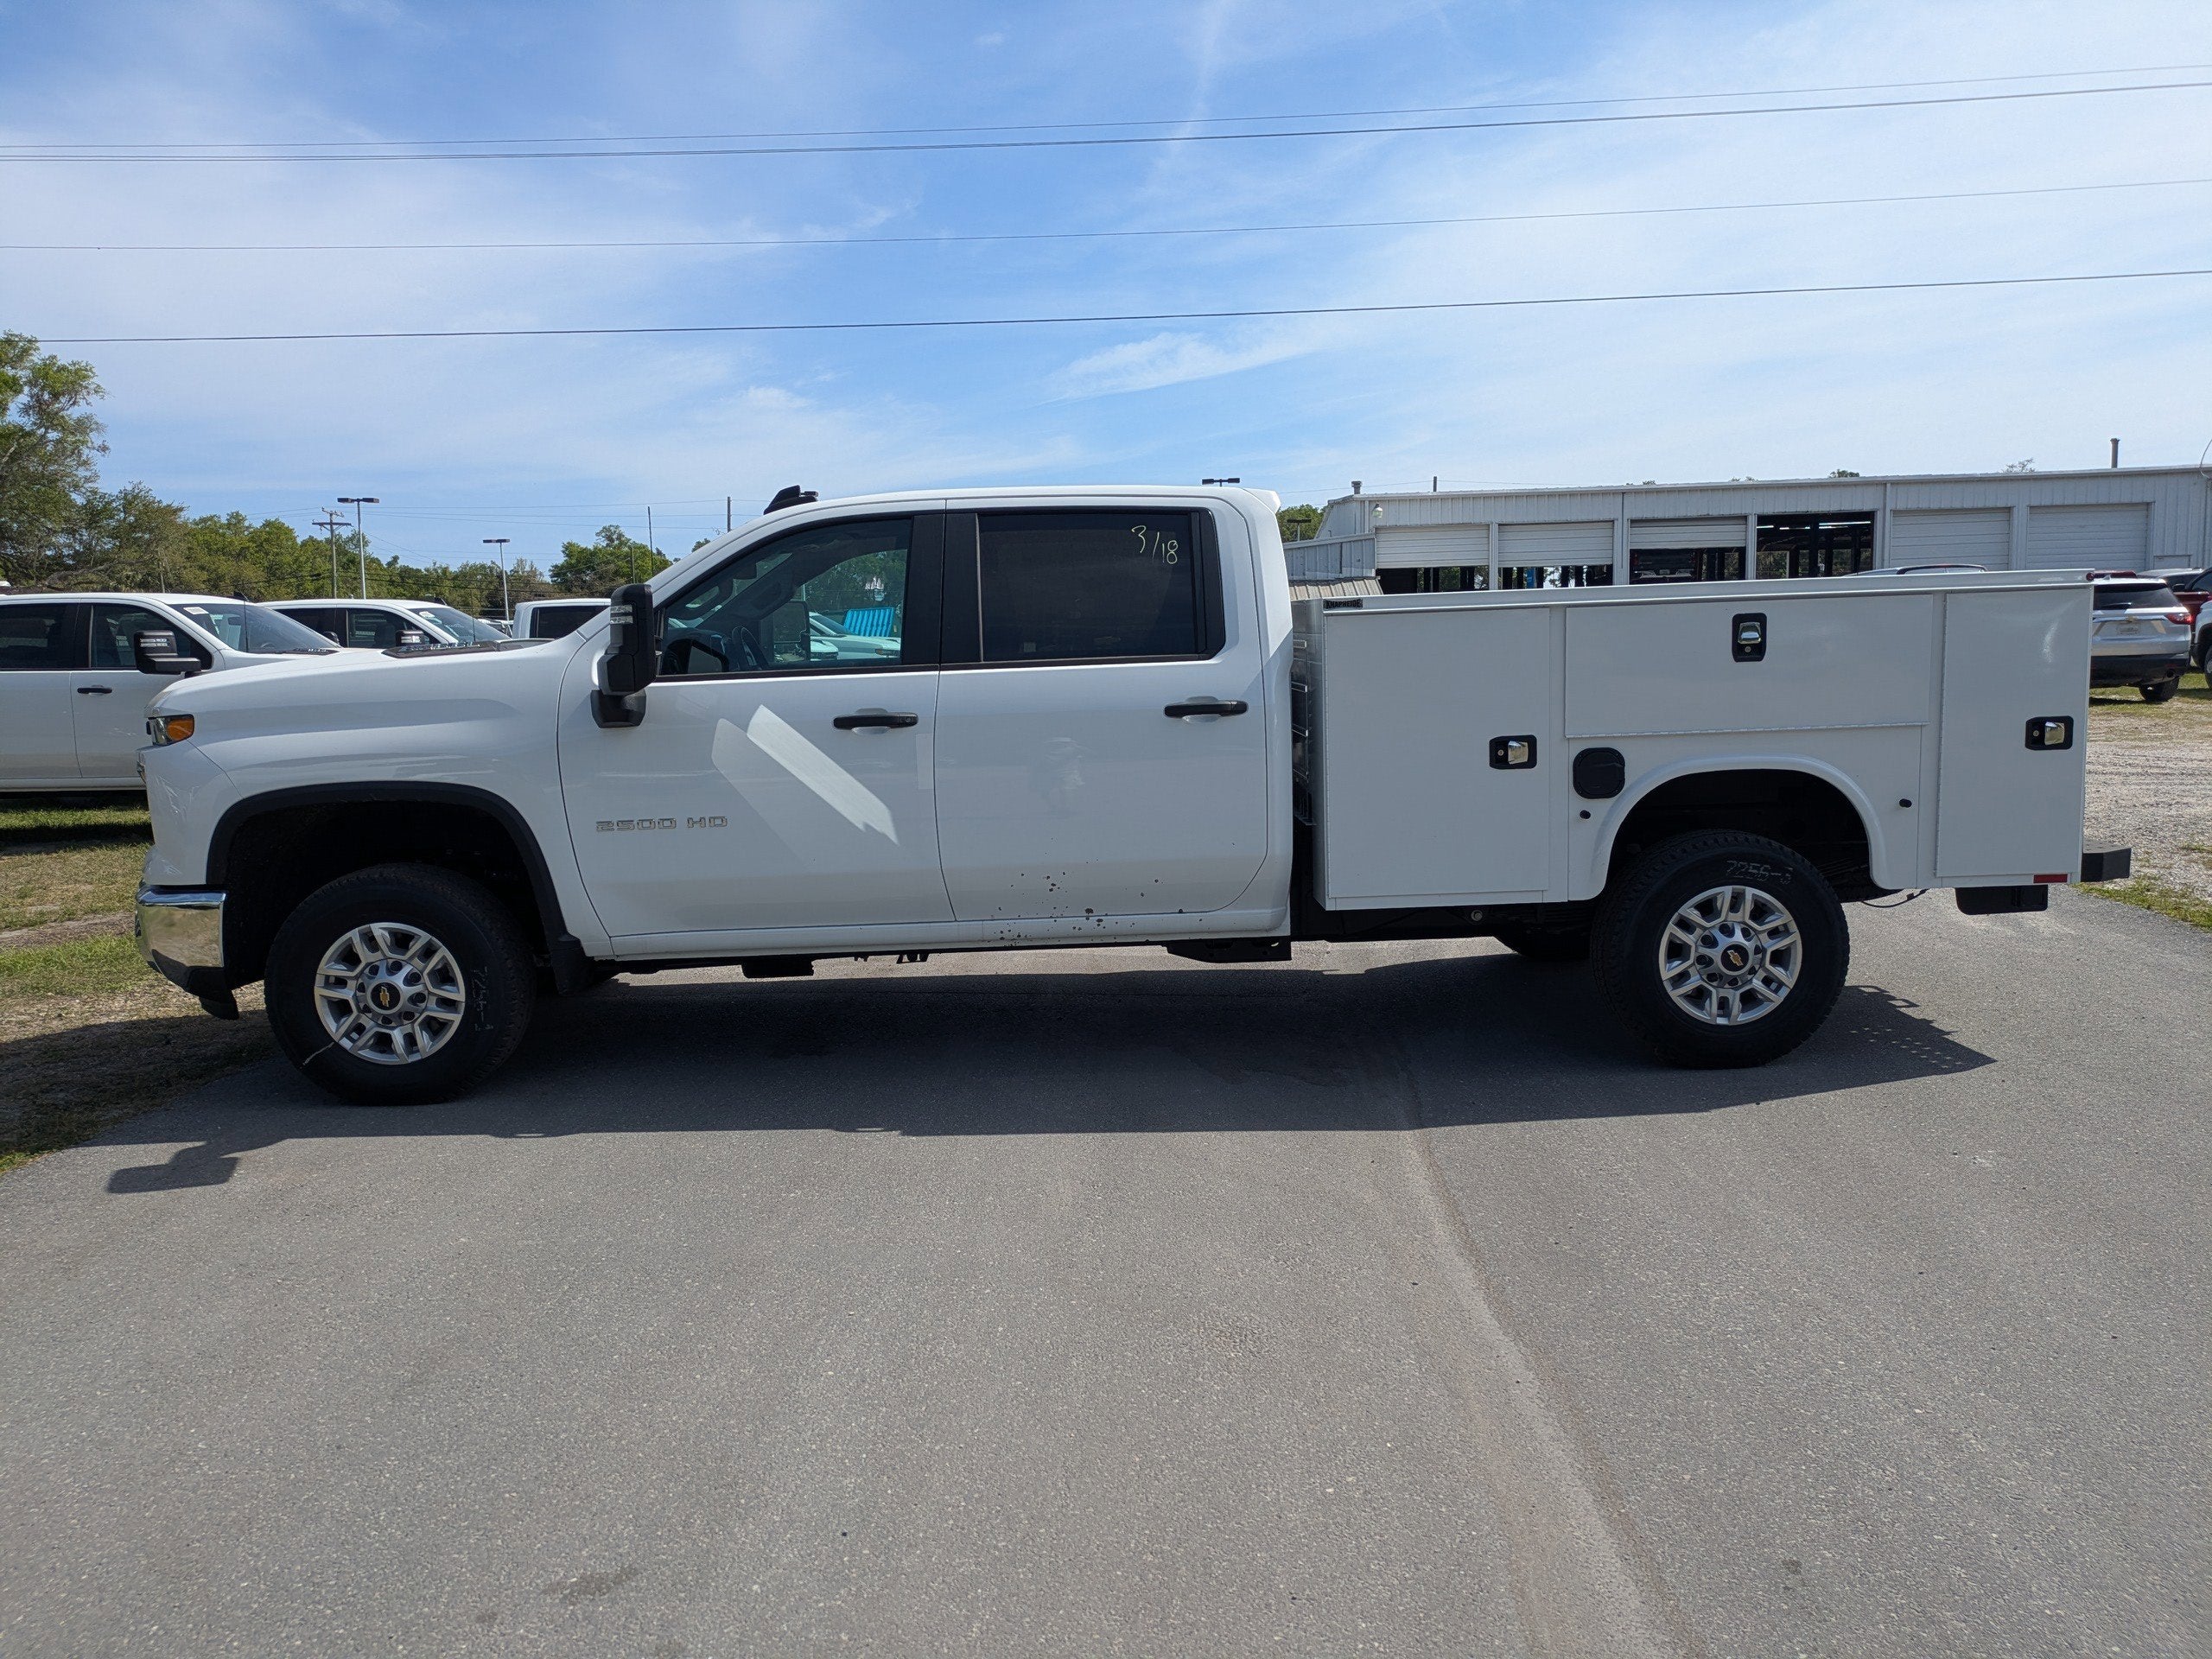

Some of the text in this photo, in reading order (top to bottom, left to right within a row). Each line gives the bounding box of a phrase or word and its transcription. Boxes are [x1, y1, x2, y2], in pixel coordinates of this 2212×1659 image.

[1131, 524, 1179, 564] 3/18
[595, 816, 728, 832] 2500 HD
